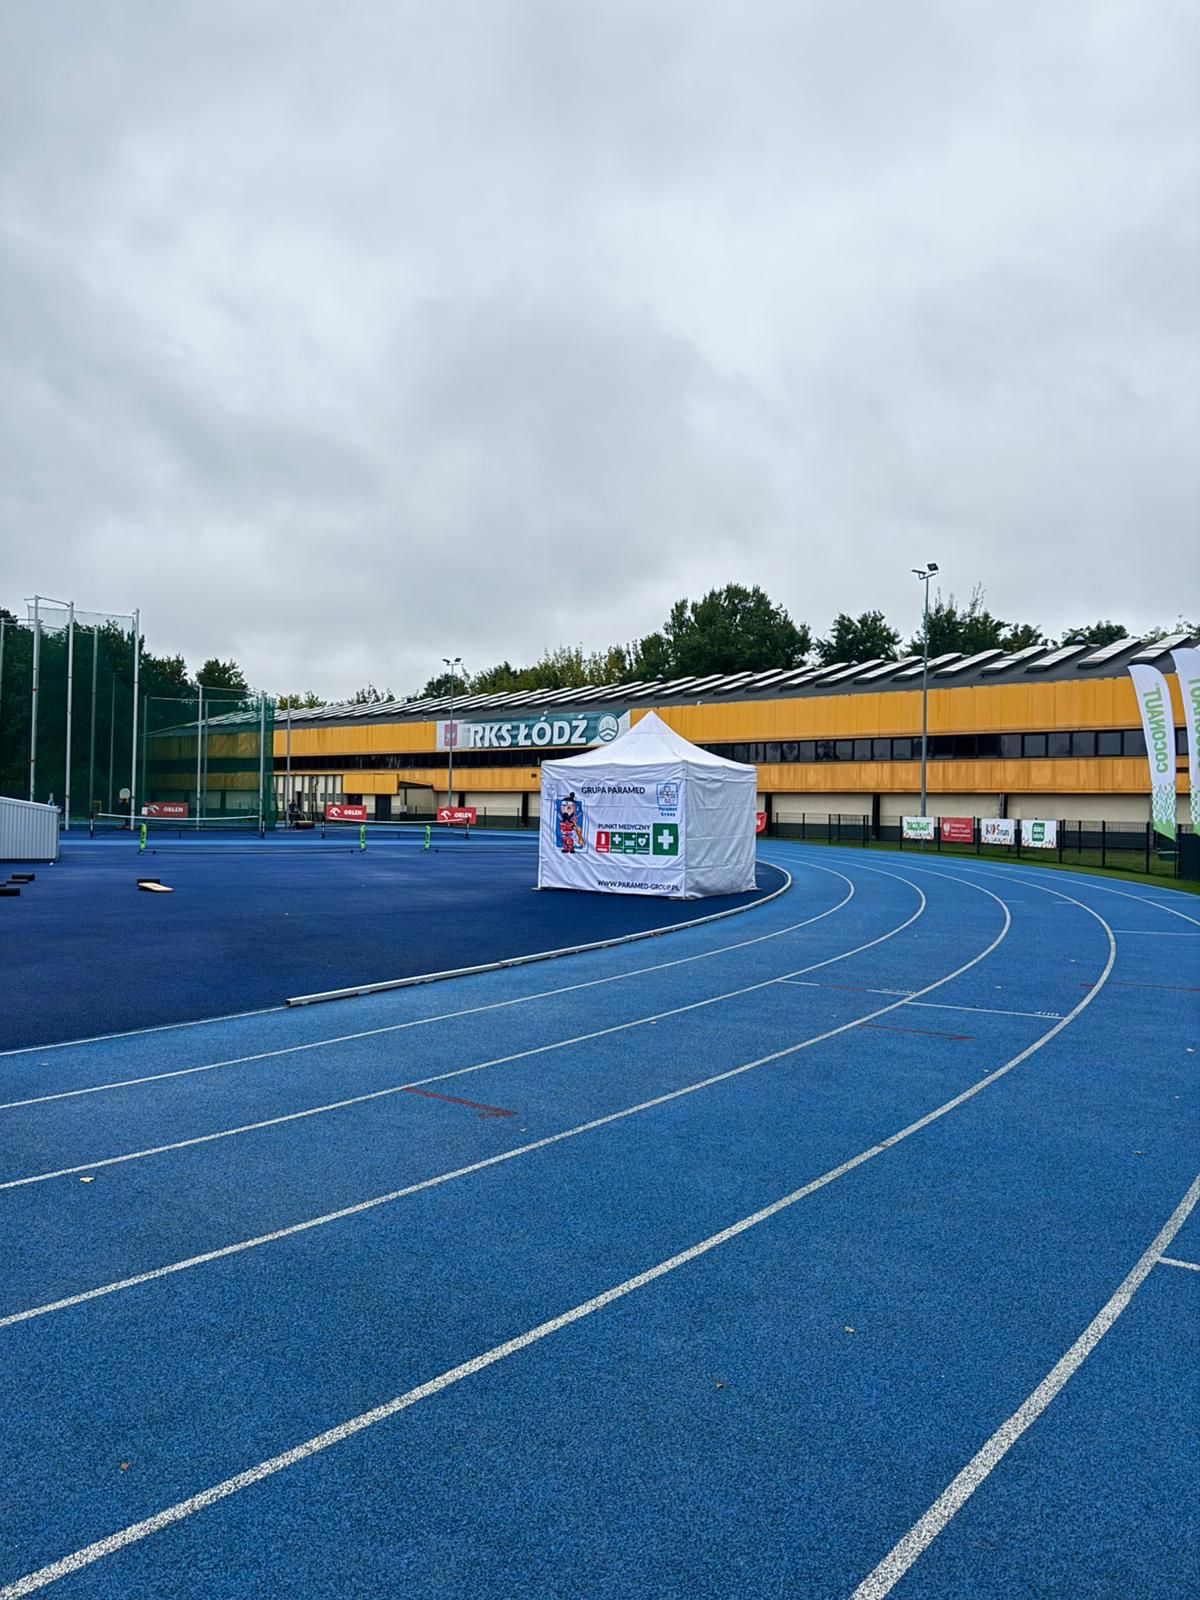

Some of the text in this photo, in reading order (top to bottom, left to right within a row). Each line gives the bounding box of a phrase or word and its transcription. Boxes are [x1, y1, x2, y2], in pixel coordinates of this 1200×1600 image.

[469, 713, 588, 747] RKS ŁÓDŹ
[581, 786, 646, 795] GRUPA PARAMED
[597, 880, 680, 892] WWW.PARAMED-GROUP.PL
